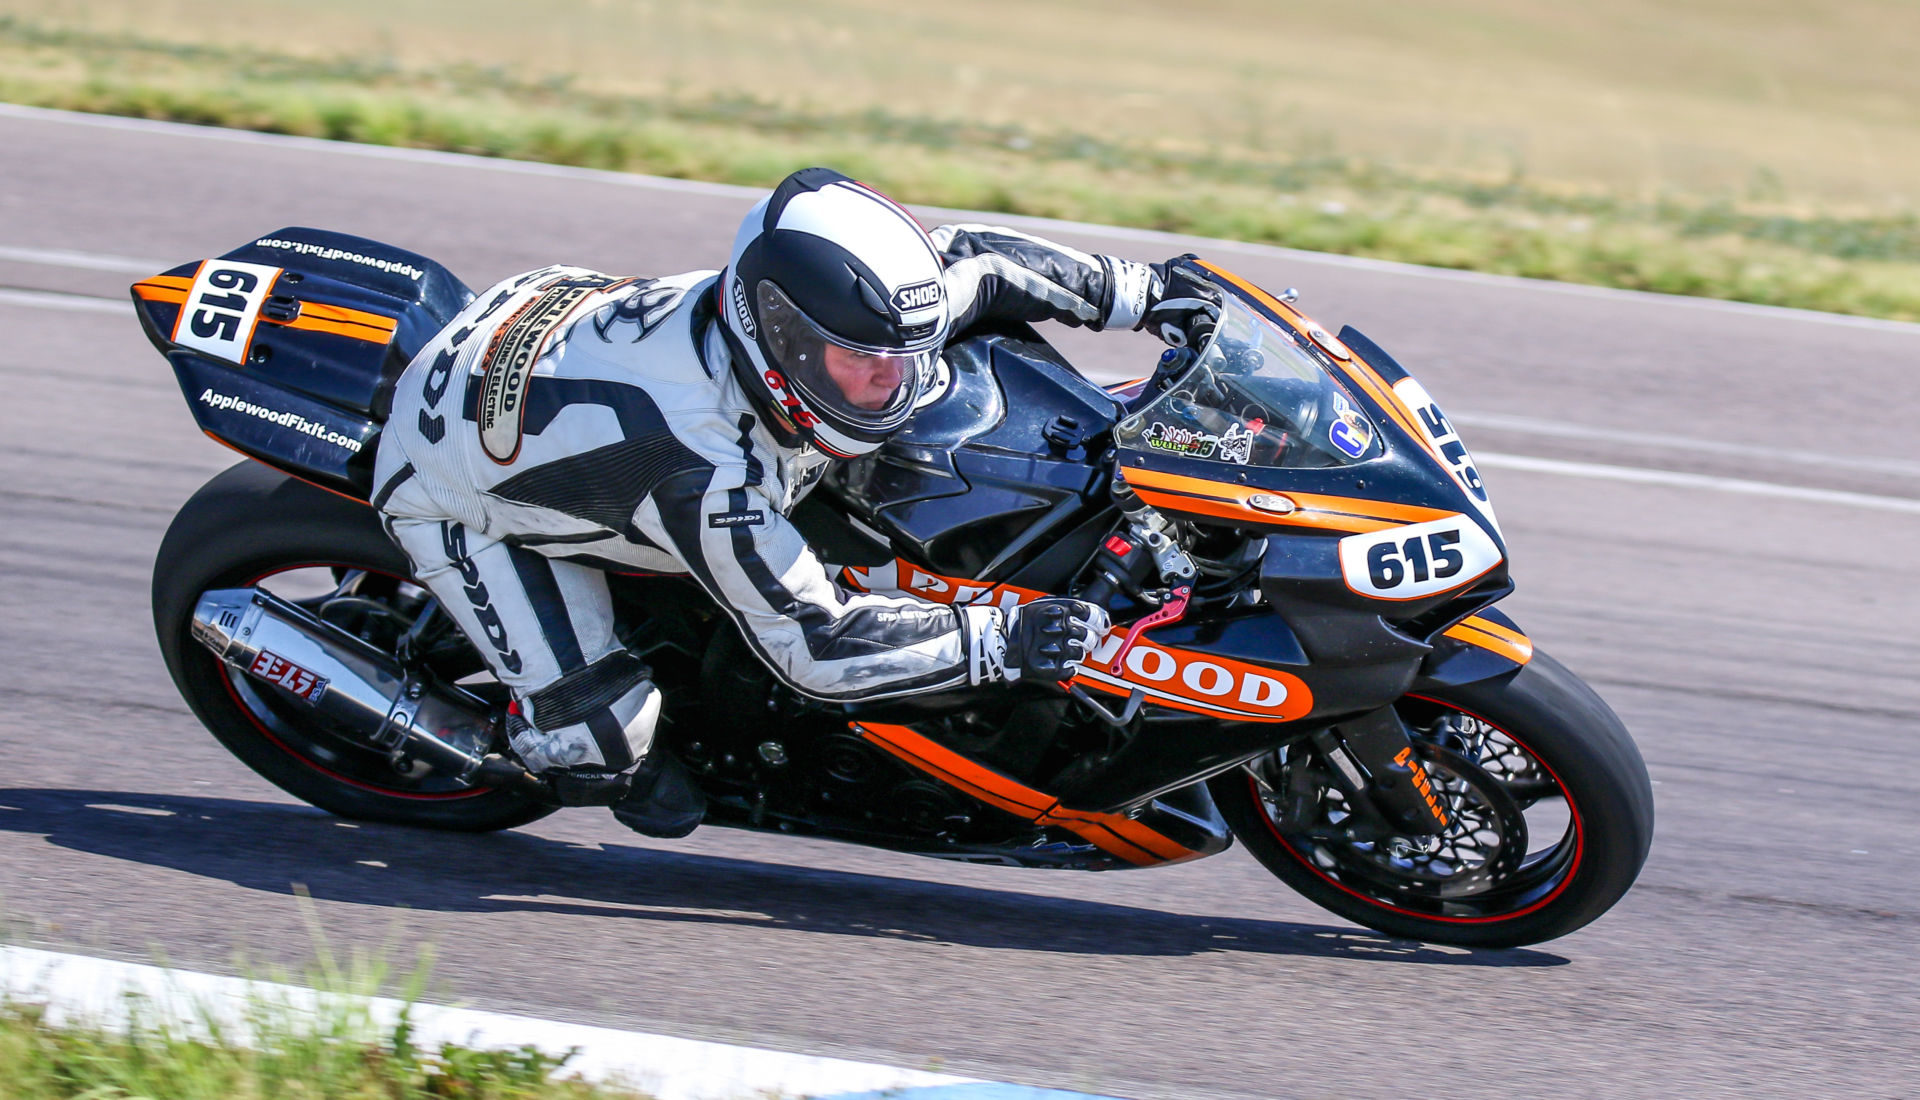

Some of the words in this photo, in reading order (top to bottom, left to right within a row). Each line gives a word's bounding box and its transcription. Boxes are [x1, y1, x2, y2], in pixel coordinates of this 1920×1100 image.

[256, 237, 423, 280] ApplewoodFixIt.com
[190, 268, 258, 342] 615
[733, 284, 752, 333] SHOEI
[900, 284, 939, 308] SHOEI
[199, 387, 363, 452] ApplewoodFixIt.com
[486, 376, 501, 429] ELECTRIC
[764, 369, 822, 427] 615
[1416, 402, 1488, 502] 615
[1366, 529, 1464, 590] 615
[253, 651, 315, 694] ヨシムラ
